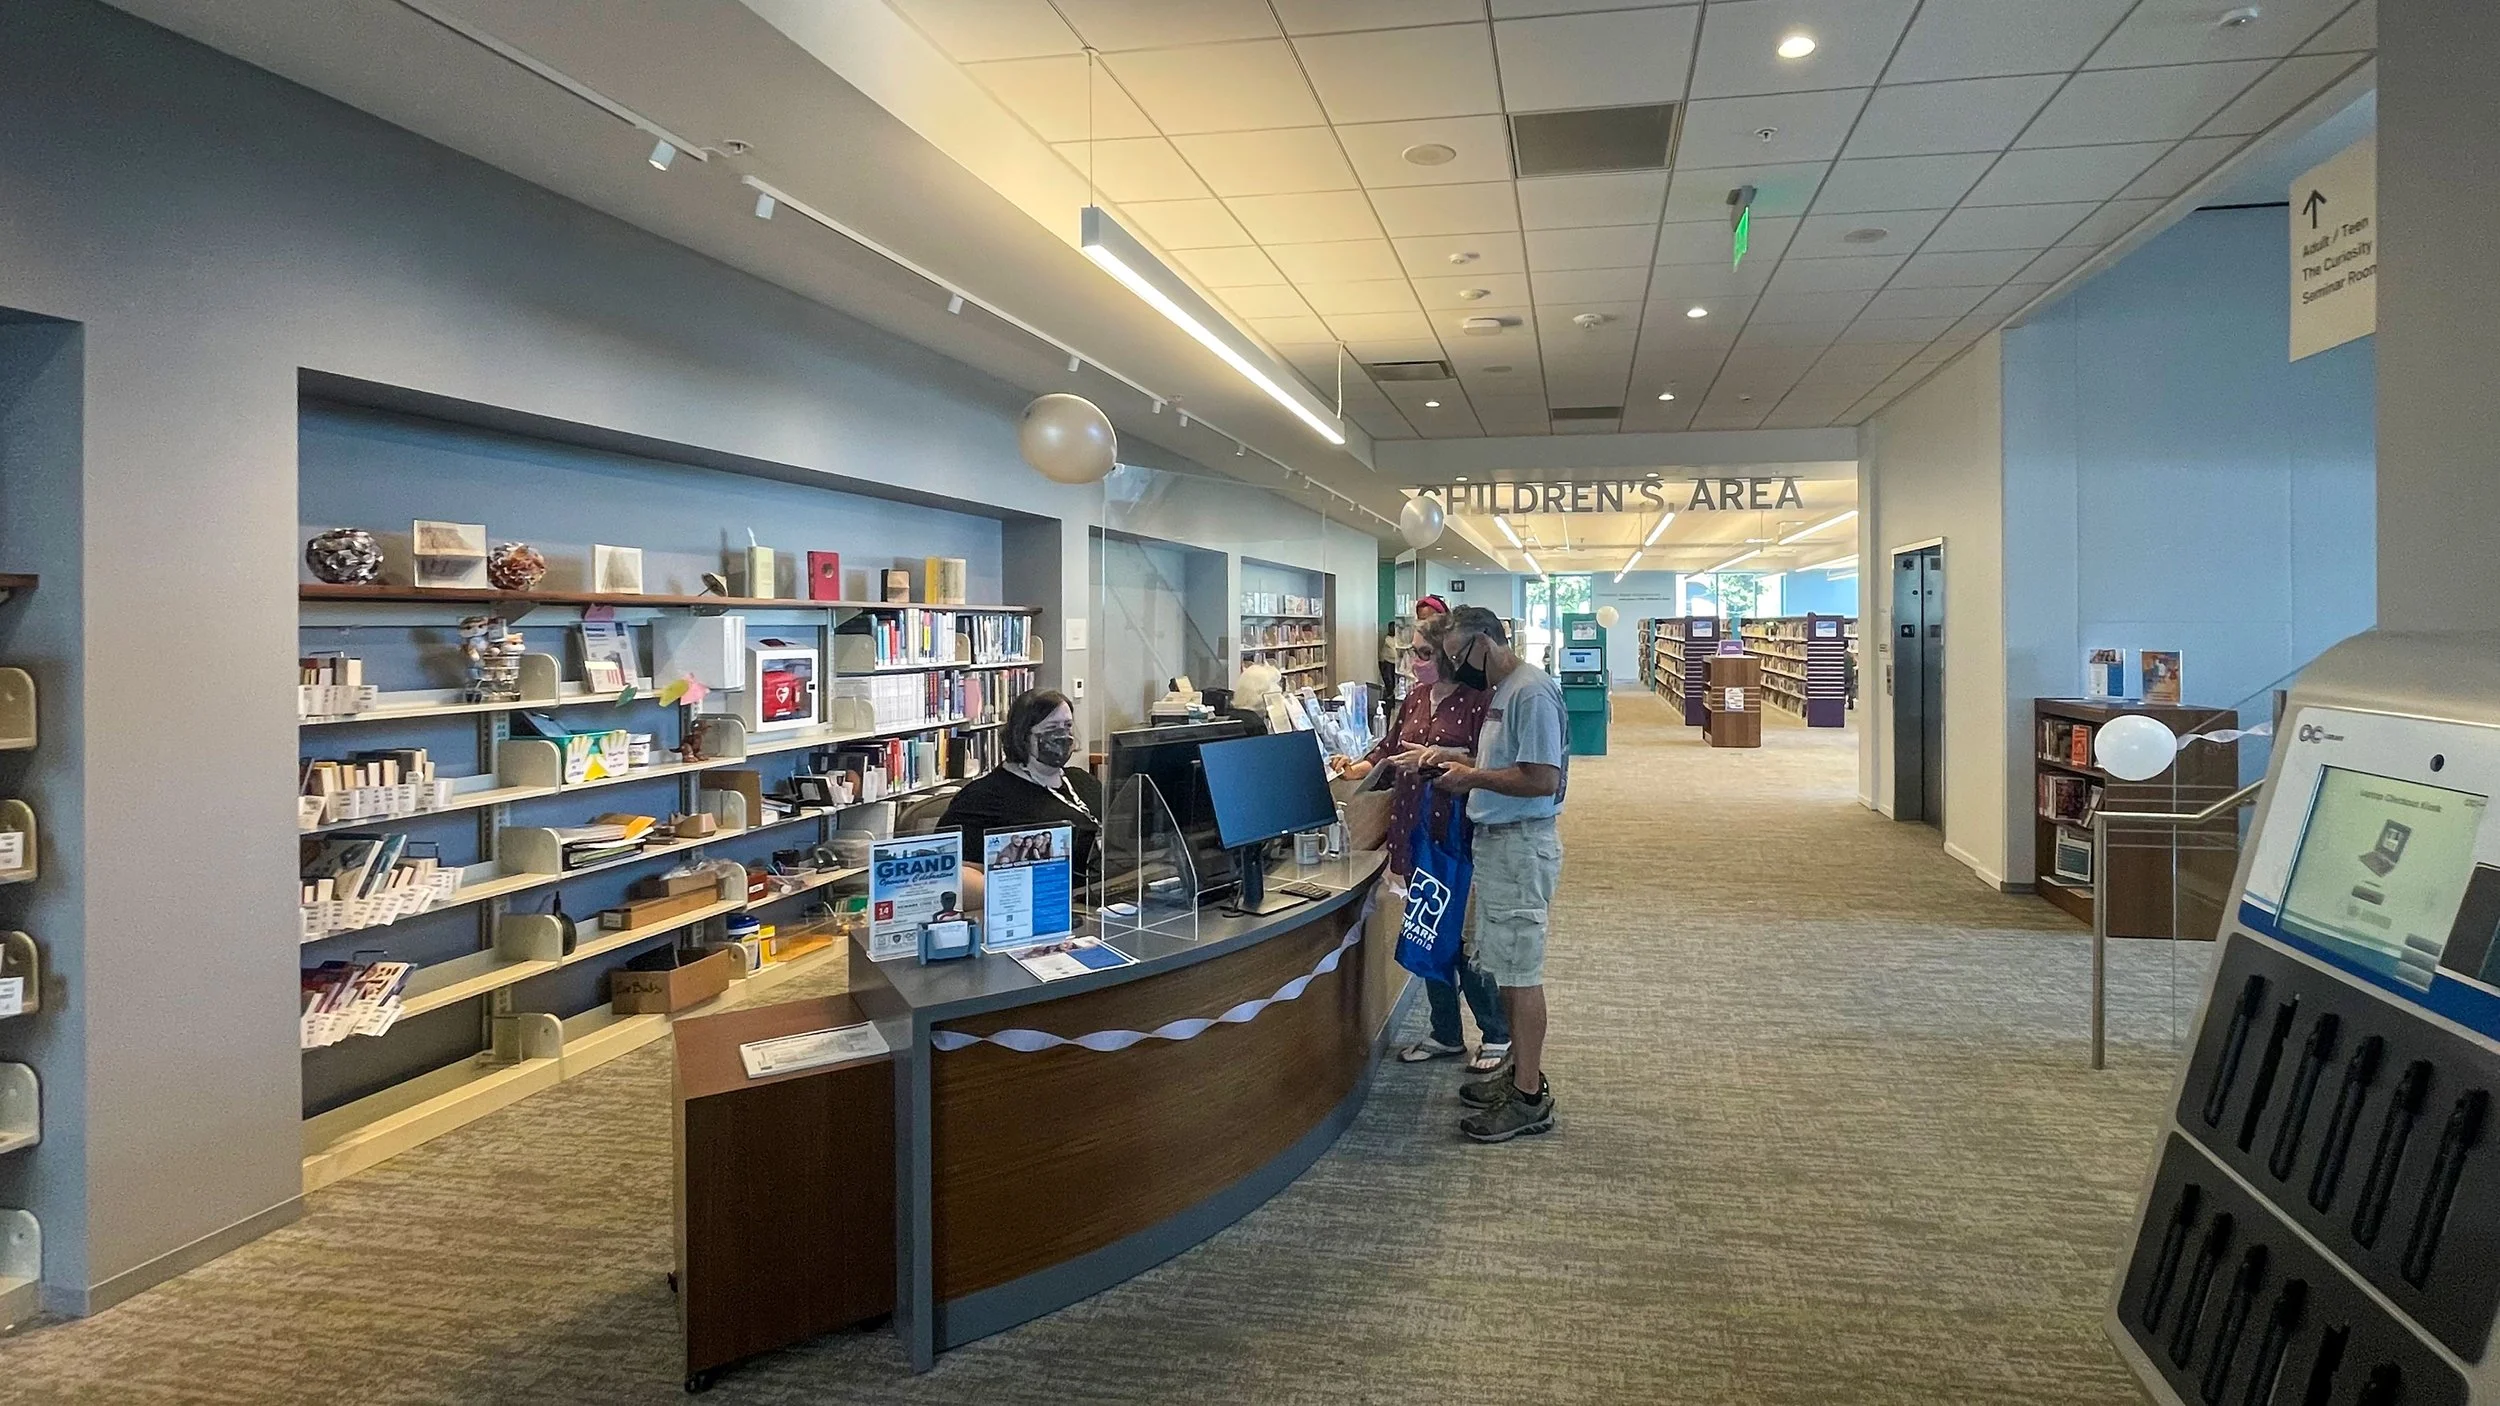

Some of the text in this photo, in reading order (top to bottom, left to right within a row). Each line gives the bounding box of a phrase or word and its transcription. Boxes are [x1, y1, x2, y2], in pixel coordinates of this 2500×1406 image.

[2303, 235, 2330, 258] Adult
[2342, 217, 2368, 236] Teen
[2302, 240, 2372, 281] The Curiosity
[2302, 278, 2345, 305] Seminar
[1688, 477, 1804, 511] AREA
[877, 855, 955, 878] GRAND
[878, 907, 890, 916] 14
[1402, 917, 1436, 944] WARK
